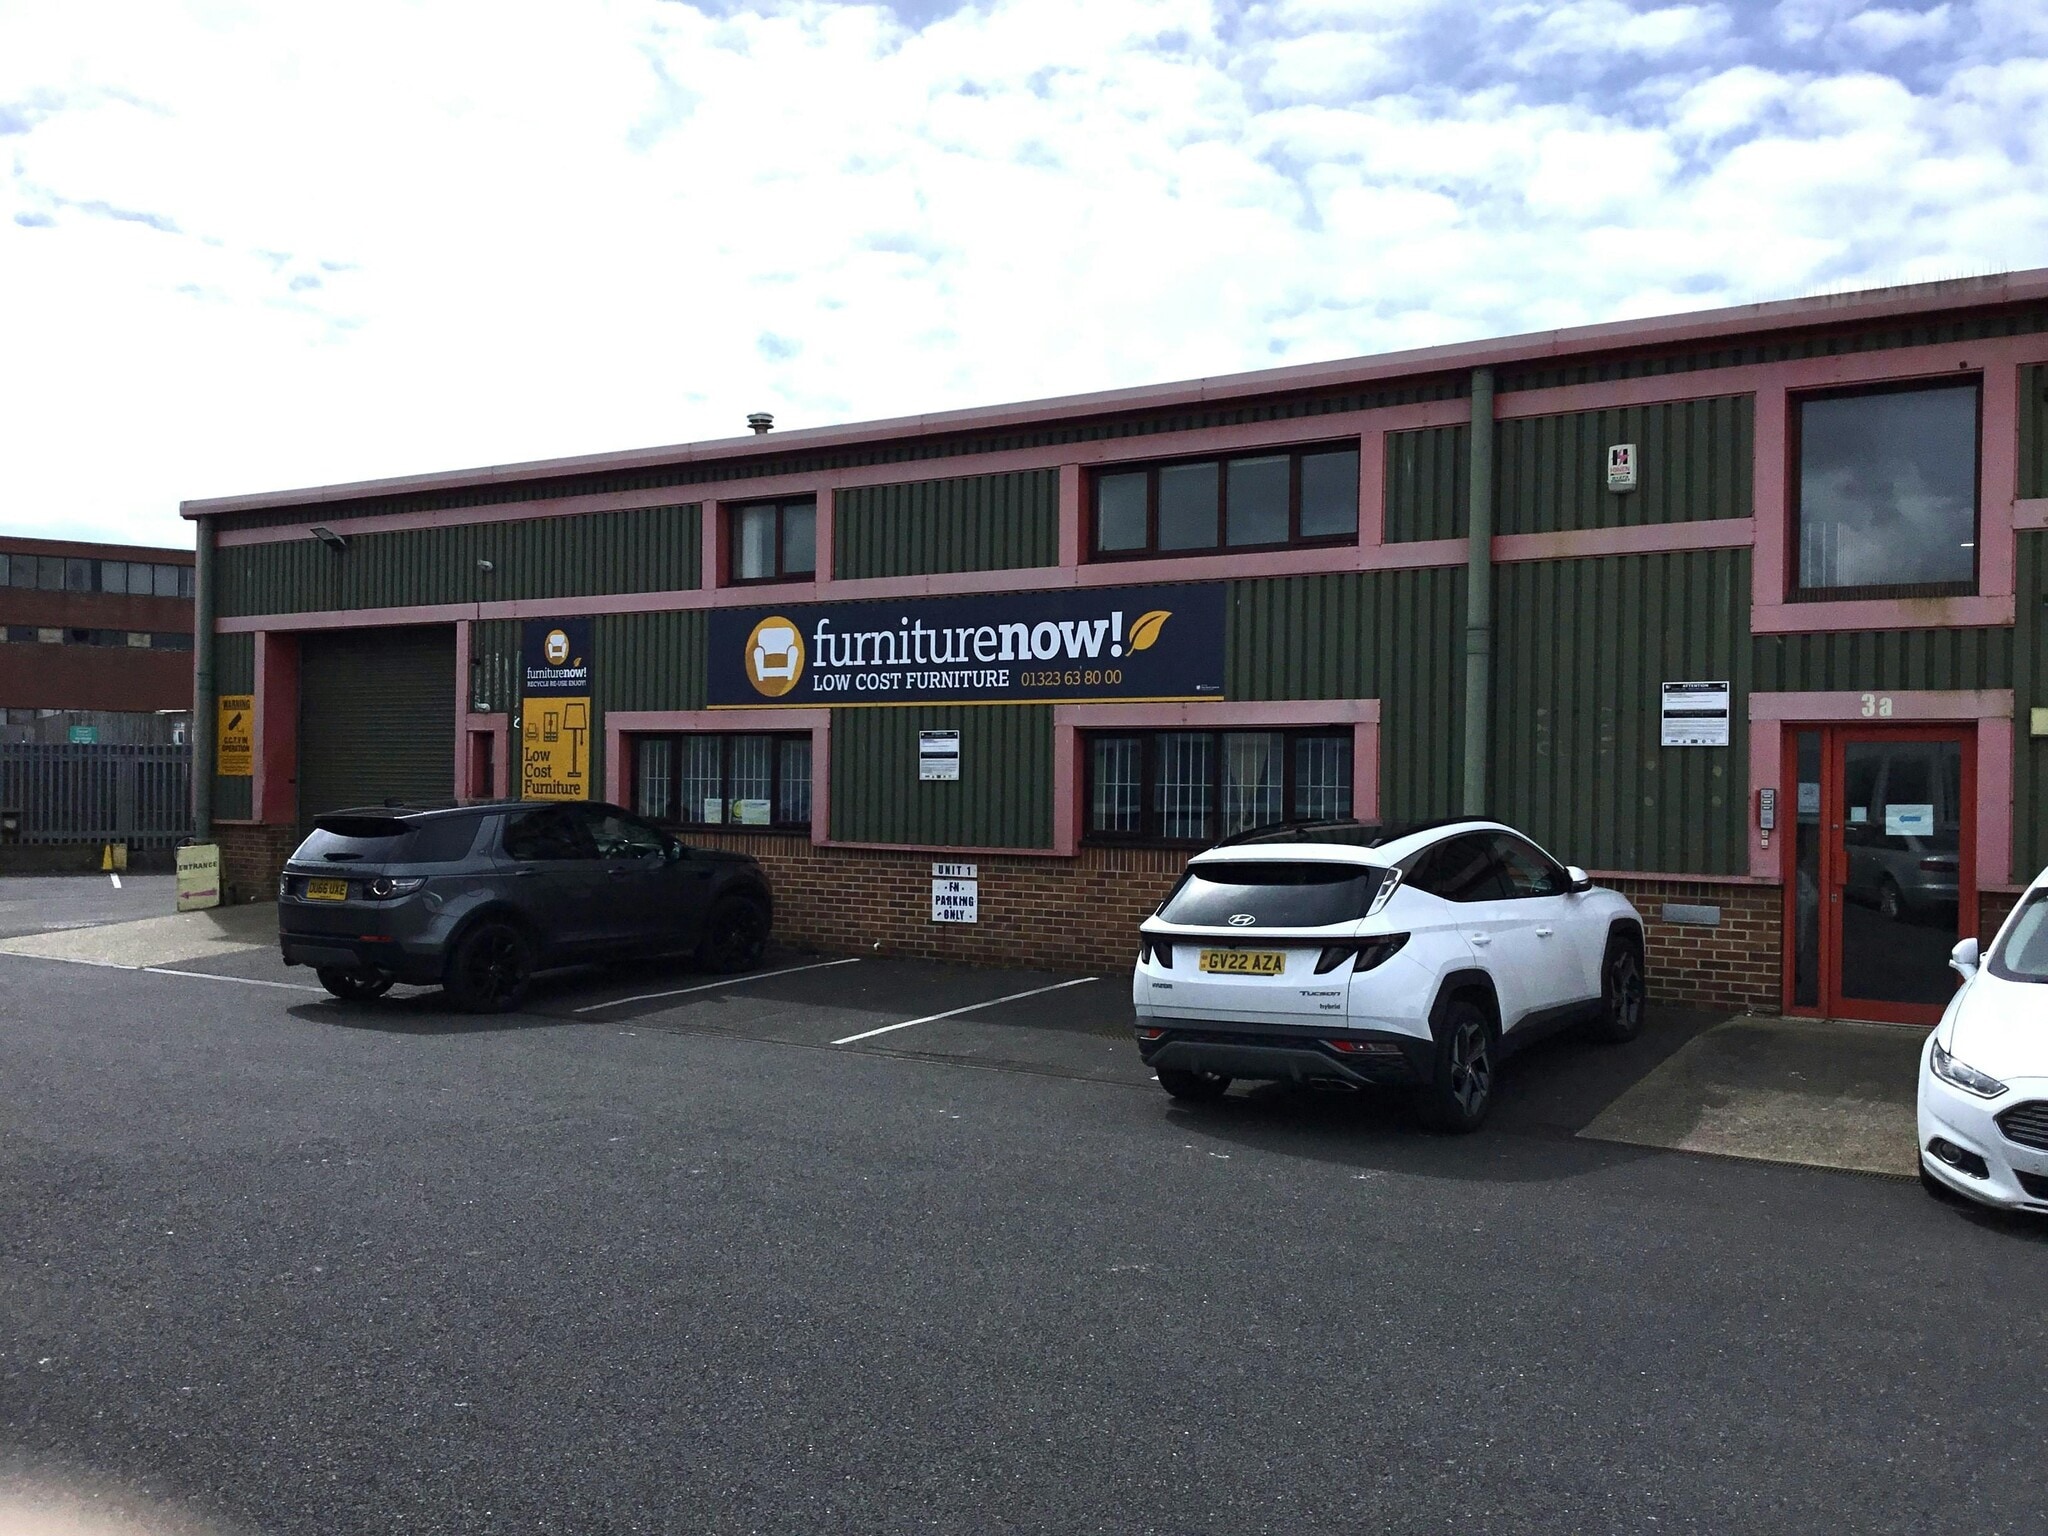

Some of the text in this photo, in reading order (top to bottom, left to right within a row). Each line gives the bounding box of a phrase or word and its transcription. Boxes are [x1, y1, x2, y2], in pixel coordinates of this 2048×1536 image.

[813, 611, 1123, 667] furniturenow!
[527, 667, 587, 679] furniturenow!
[813, 669, 1122, 691] LOW COST FURNITURE 01323 63 80 00
[1861, 693, 1893, 717] 3a
[525, 747, 551, 761] Low
[525, 763, 552, 778] Cost
[524, 779, 581, 795] Furniture
[178, 861, 218, 872] ENTRANCE
[938, 865, 971, 876] UNIT 1
[935, 895, 974, 907] PARKING
[944, 909, 965, 920] ONLY
[1209, 953, 1249, 970] GV22
[1251, 954, 1282, 972] AZA
